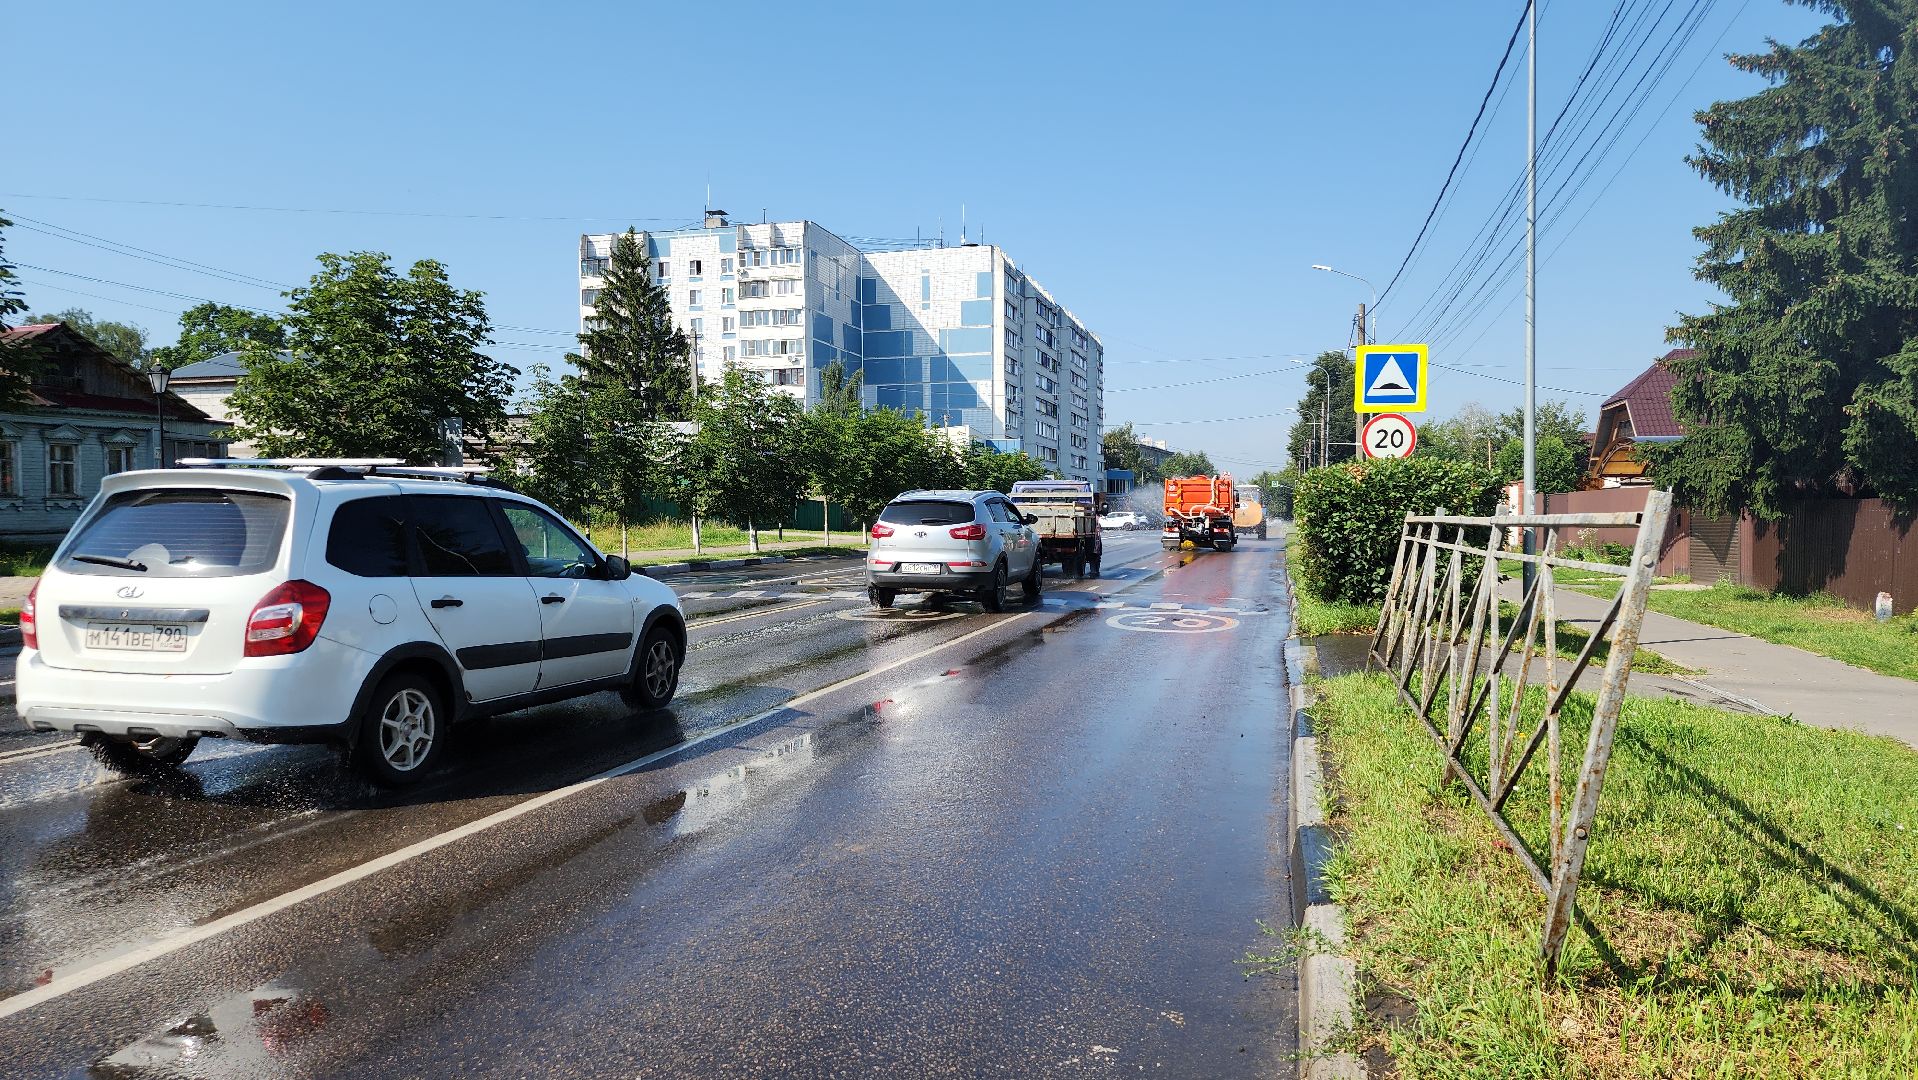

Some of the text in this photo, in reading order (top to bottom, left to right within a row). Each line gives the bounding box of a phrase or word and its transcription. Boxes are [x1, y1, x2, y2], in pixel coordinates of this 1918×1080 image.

[1375, 429, 1404, 448] 20
[1131, 615, 1212, 628] 20
[89, 627, 182, 646] М141ВЕ 790
